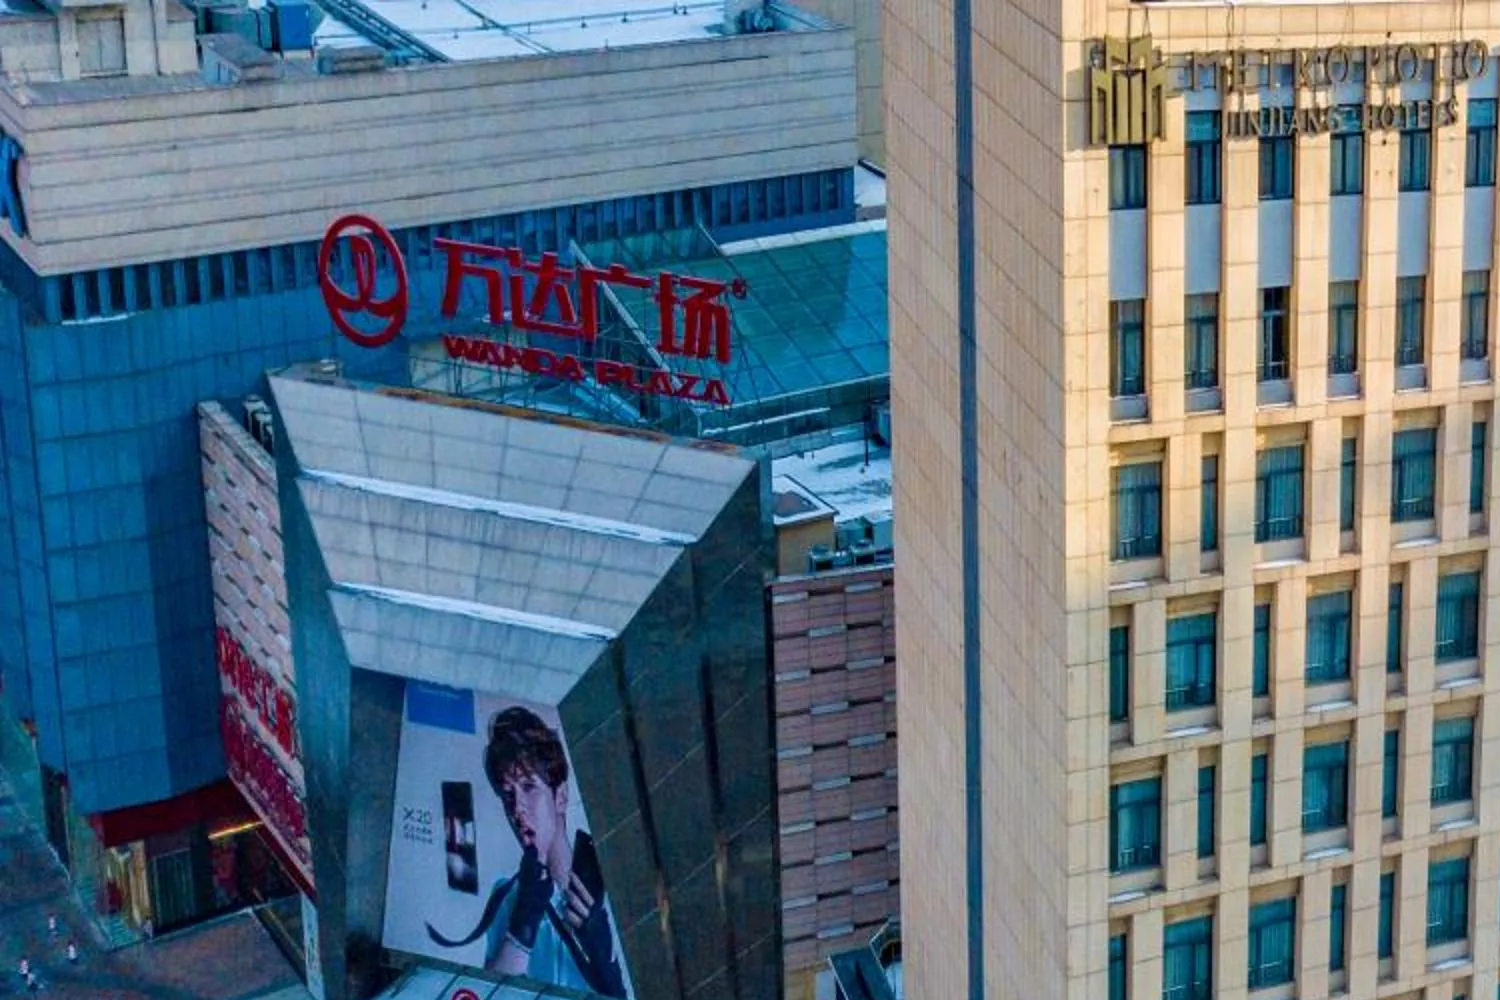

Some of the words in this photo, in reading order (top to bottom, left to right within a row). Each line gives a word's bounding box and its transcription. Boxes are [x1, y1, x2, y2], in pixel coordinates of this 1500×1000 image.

[1190, 39, 1490, 92] METROPOLO
[1366, 98, 1458, 131] HOTELS
[434, 237, 730, 364] 万达广场
[442, 335, 584, 381] WANDA
[596, 362, 731, 405] PLAZA
